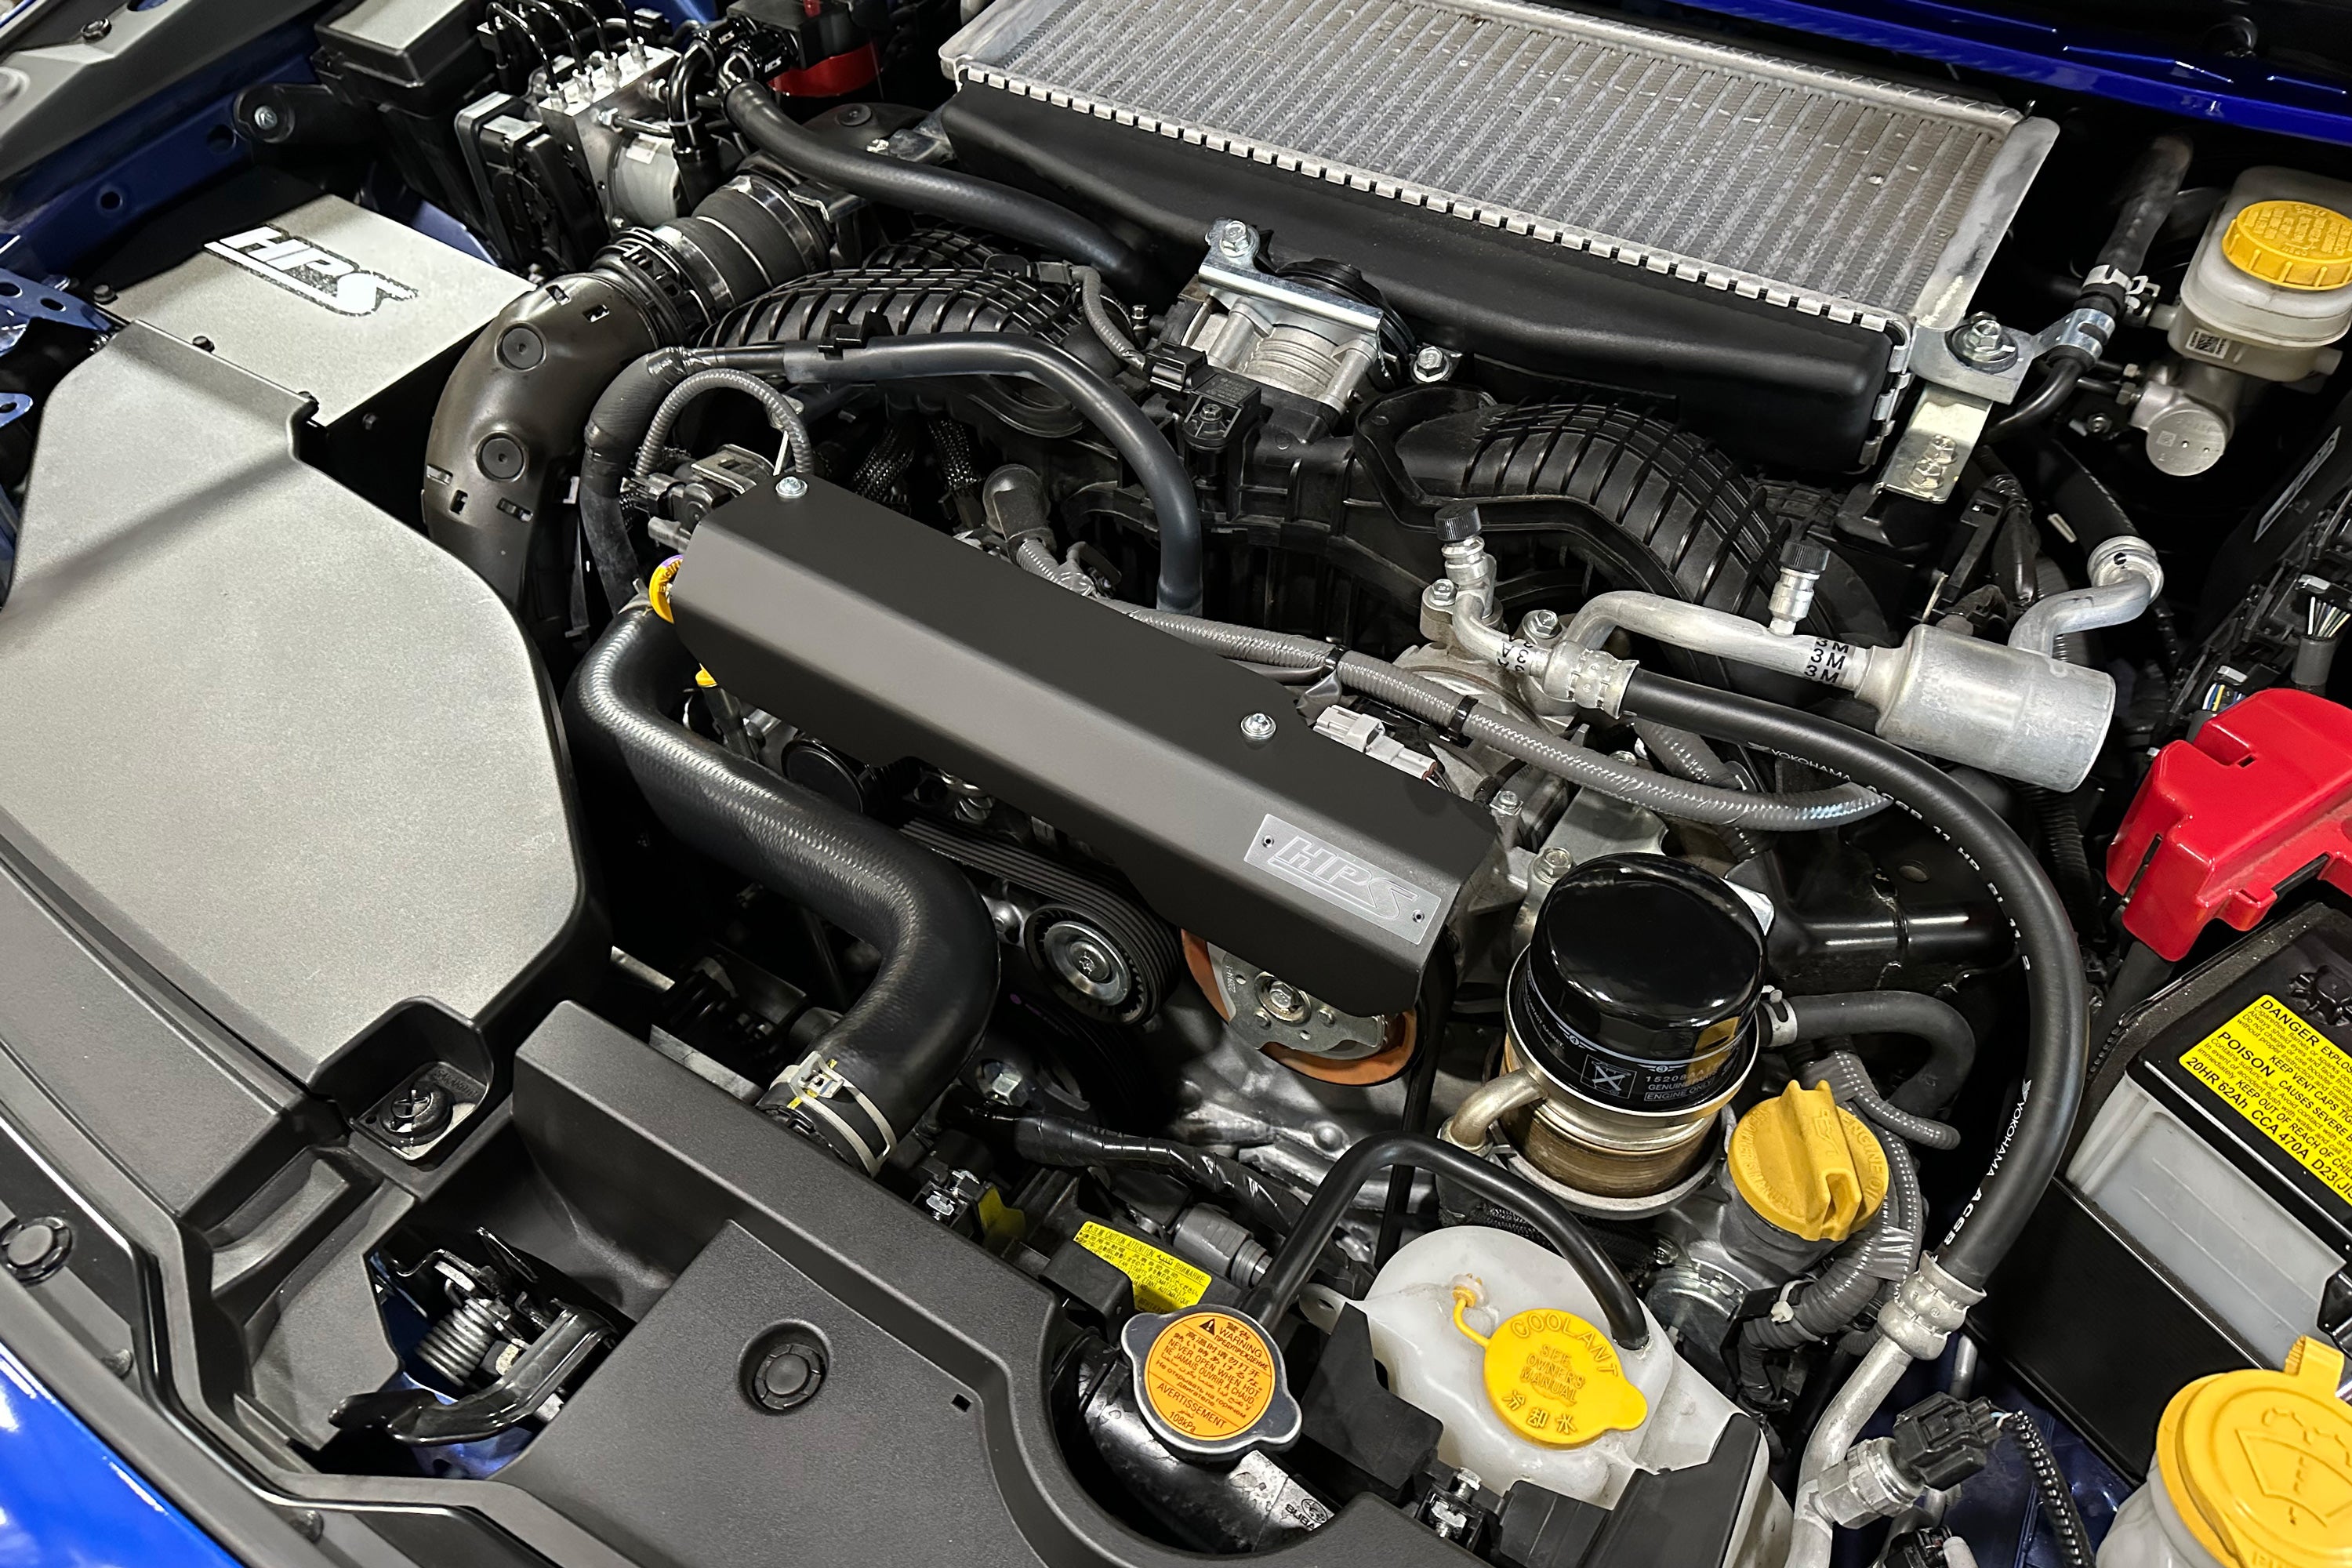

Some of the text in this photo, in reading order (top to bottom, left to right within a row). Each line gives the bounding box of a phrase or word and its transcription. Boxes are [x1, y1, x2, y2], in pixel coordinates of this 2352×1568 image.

[203, 223, 419, 317] HPS
[1771, 749, 1851, 782] YOKOHAMA
[1267, 835, 1420, 920] HPS
[2241, 1014, 2255, 1023] Do
[2251, 1022, 2265, 1032] not
[2261, 1030, 2288, 1051] charge
[2293, 1054, 2308, 1065] use
[2306, 1064, 2336, 1086] booster
[2247, 1010, 2273, 1029] Always
[2270, 1027, 2292, 1044] shield
[2288, 1043, 2308, 1058] eyes
[2306, 1054, 2322, 1067] and
[2318, 1065, 2337, 1080] face
[2258, 1000, 2324, 1047] DANGER
[2235, 1018, 2261, 1037] without
[2257, 1036, 2281, 1054] proper
[2279, 1053, 2316, 1080] instruction
[2313, 1079, 2329, 1091] and
[2287, 1031, 2311, 1049] flames
[2315, 1055, 2342, 1075] sparks
[1646, 1091, 1687, 1100] ENGINE
[2186, 1055, 2221, 1084] 20HR
[2216, 1080, 2252, 1109] 62Ah
[2249, 1108, 2282, 1134] CCA
[2276, 1131, 2312, 1160] 470A
[2209, 1037, 2241, 1062] Contains
[2277, 1091, 2299, 1109] Avoid
[2296, 1107, 2324, 1129] contact
[2321, 1127, 2338, 1141] with
[2210, 1048, 2230, 1065] event
[2229, 1062, 2239, 1071] of
[2236, 1069, 2267, 1093] accident
[2263, 1091, 2283, 1105] flush
[2280, 1104, 2297, 1118] with
[2294, 1116, 2315, 1133] water
[2314, 1131, 2330, 1144] and
[2327, 1142, 2343, 1155] call
[2216, 1031, 2276, 1077] POISON
[2277, 1079, 2315, 1109] CAUSES
[2310, 1106, 2349, 1136] SEVERE
[2267, 1054, 2294, 1075] KEEP
[2290, 1072, 2317, 1092] VENT
[2312, 1090, 2339, 1111] CAPS
[1842, 1115, 1882, 1173] ENGINE
[2234, 1079, 2261, 1100] KEEP
[2256, 1097, 2279, 1115] OUT
[2274, 1112, 2292, 1125] OF
[2288, 1122, 2321, 1149] REACH
[2317, 1146, 2335, 1160] OF
[1944, 1102, 2027, 1246] YOKOHAMA AC6B
[1105, 1229, 1126, 1246] CAUTION
[1126, 1238, 1155, 1258] ATTENTION
[1163, 1345, 1173, 1355] NE
[1173, 1351, 1199, 1370] JAMAIS
[1198, 1367, 1224, 1385] OUVRIR
[1167, 1338, 1193, 1358] NEVER
[1193, 1354, 1216, 1371] OPEN
[1216, 1368, 1241, 1387] WHEN
[1213, 1334, 1269, 1371] ПРЕДУПРЕЖДЕНИЕ
[1217, 1327, 1263, 1358] WARNING
[1510, 1312, 1619, 1378] COOLANT
[1540, 1344, 1572, 1365] SEE
[1155, 1381, 1227, 1429] AVERTISSEMENT
[1520, 1366, 1577, 1403] MANUAL
[1167, 1410, 1197, 1432] 108kPa
[1501, 1390, 1577, 1435] 冷却水
